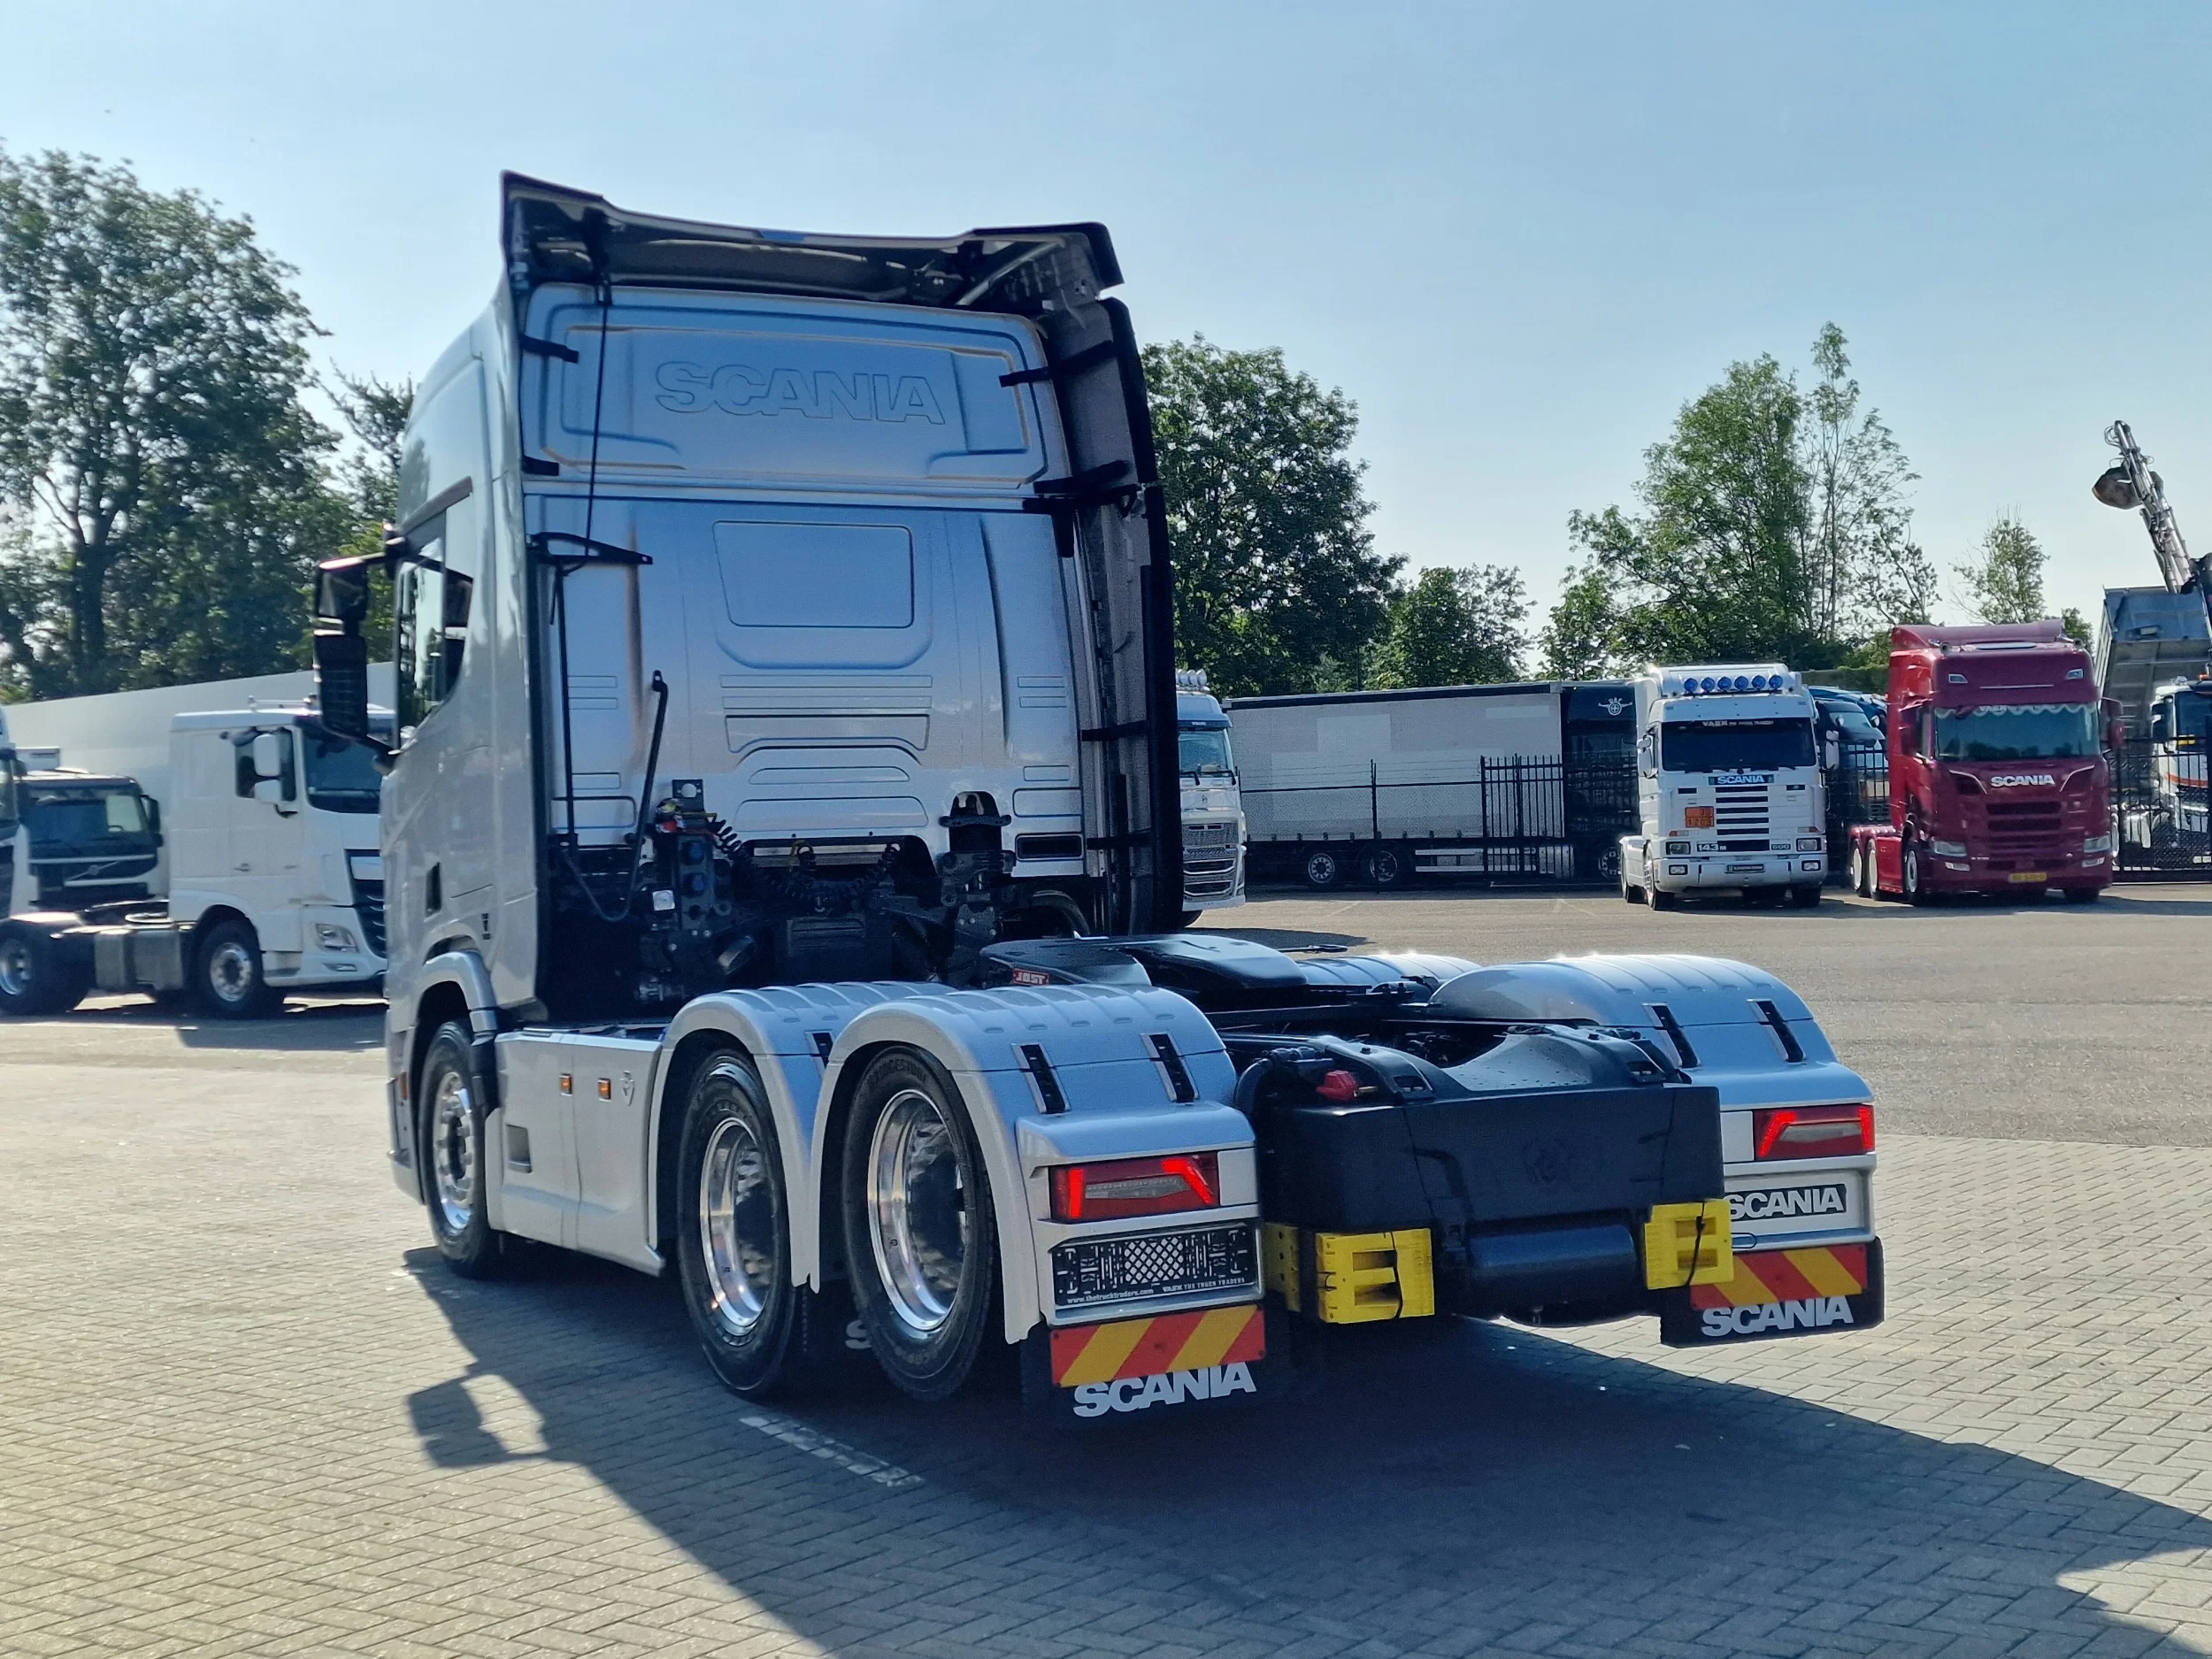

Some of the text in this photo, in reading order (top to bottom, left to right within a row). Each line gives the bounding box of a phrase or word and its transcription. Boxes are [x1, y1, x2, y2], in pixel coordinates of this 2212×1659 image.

[655, 361, 946, 425] SCANIA
[1717, 775, 1765, 784] SCANIA
[1991, 774, 2055, 787] SCANIA
[1015, 972, 1046, 985] JOST
[1729, 1187, 1844, 1220] SCANIA
[1218, 1277, 1245, 1286] TRADERS
[1067, 1288, 1154, 1304] www.thetrucktraders.com
[1701, 1295, 1854, 1336] SCANIA
[1073, 1362, 1256, 1417] SCANIA
